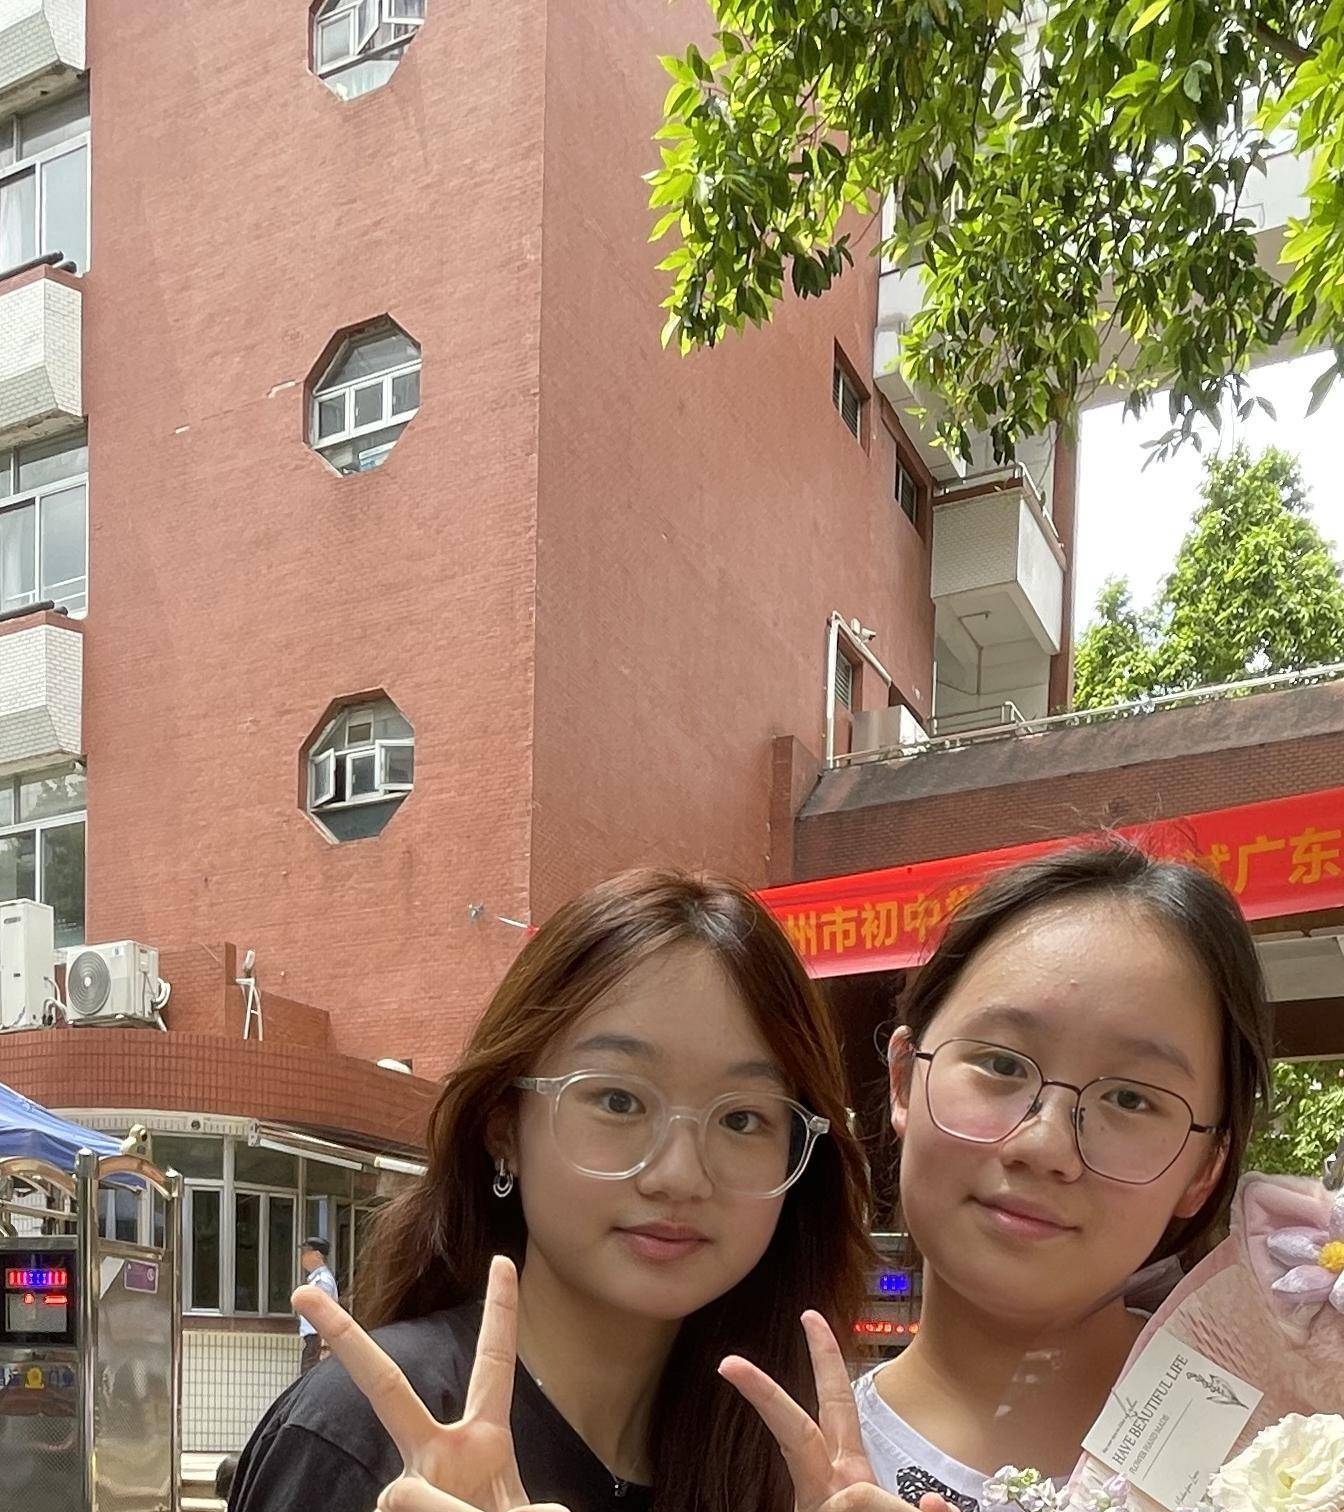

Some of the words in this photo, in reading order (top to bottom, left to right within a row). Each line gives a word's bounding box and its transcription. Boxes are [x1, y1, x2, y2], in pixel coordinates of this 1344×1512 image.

[1112, 1435, 1137, 1465] HAVE
[1129, 1379, 1173, 1439] BEAUTIFUL
[1166, 1354, 1189, 1381] LIFE
